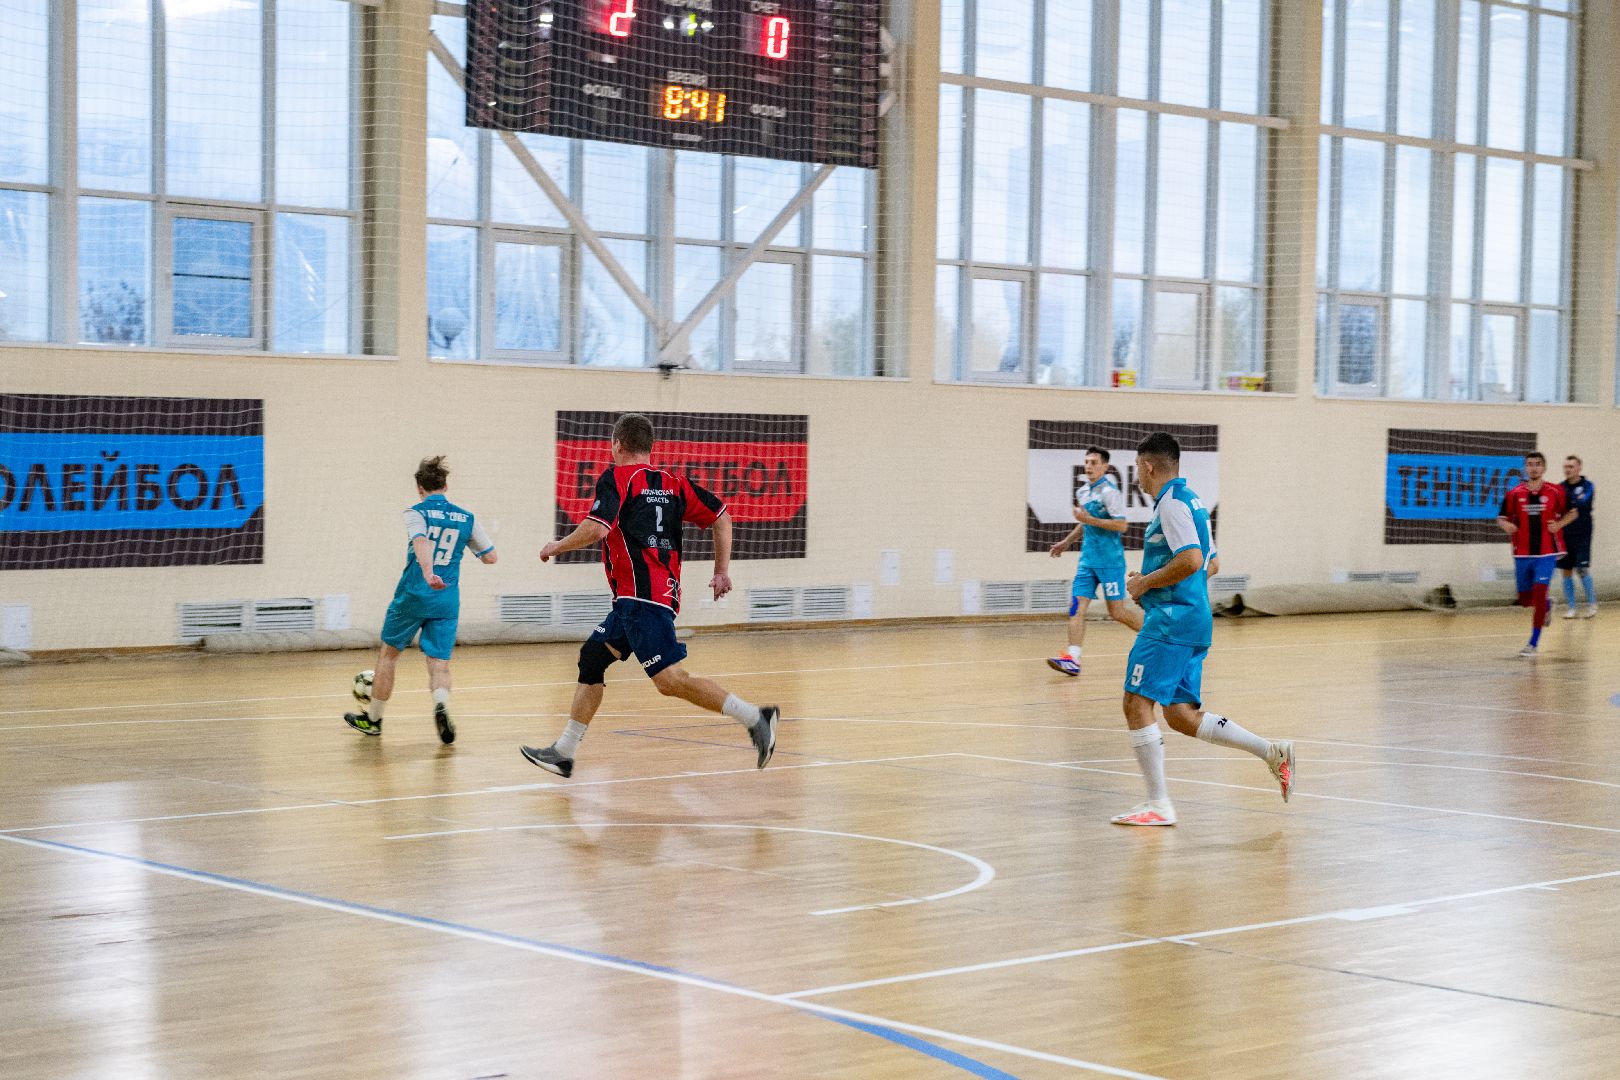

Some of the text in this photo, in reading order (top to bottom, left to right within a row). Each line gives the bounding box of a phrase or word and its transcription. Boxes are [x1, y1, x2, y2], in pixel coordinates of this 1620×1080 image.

[767, 17, 790, 59] 0
[663, 85, 726, 122] 8:41
[577, 461, 793, 498] БЕТБОЛ
[1105, 581, 1121, 597] 21
[1131, 663, 1144, 687] 9
